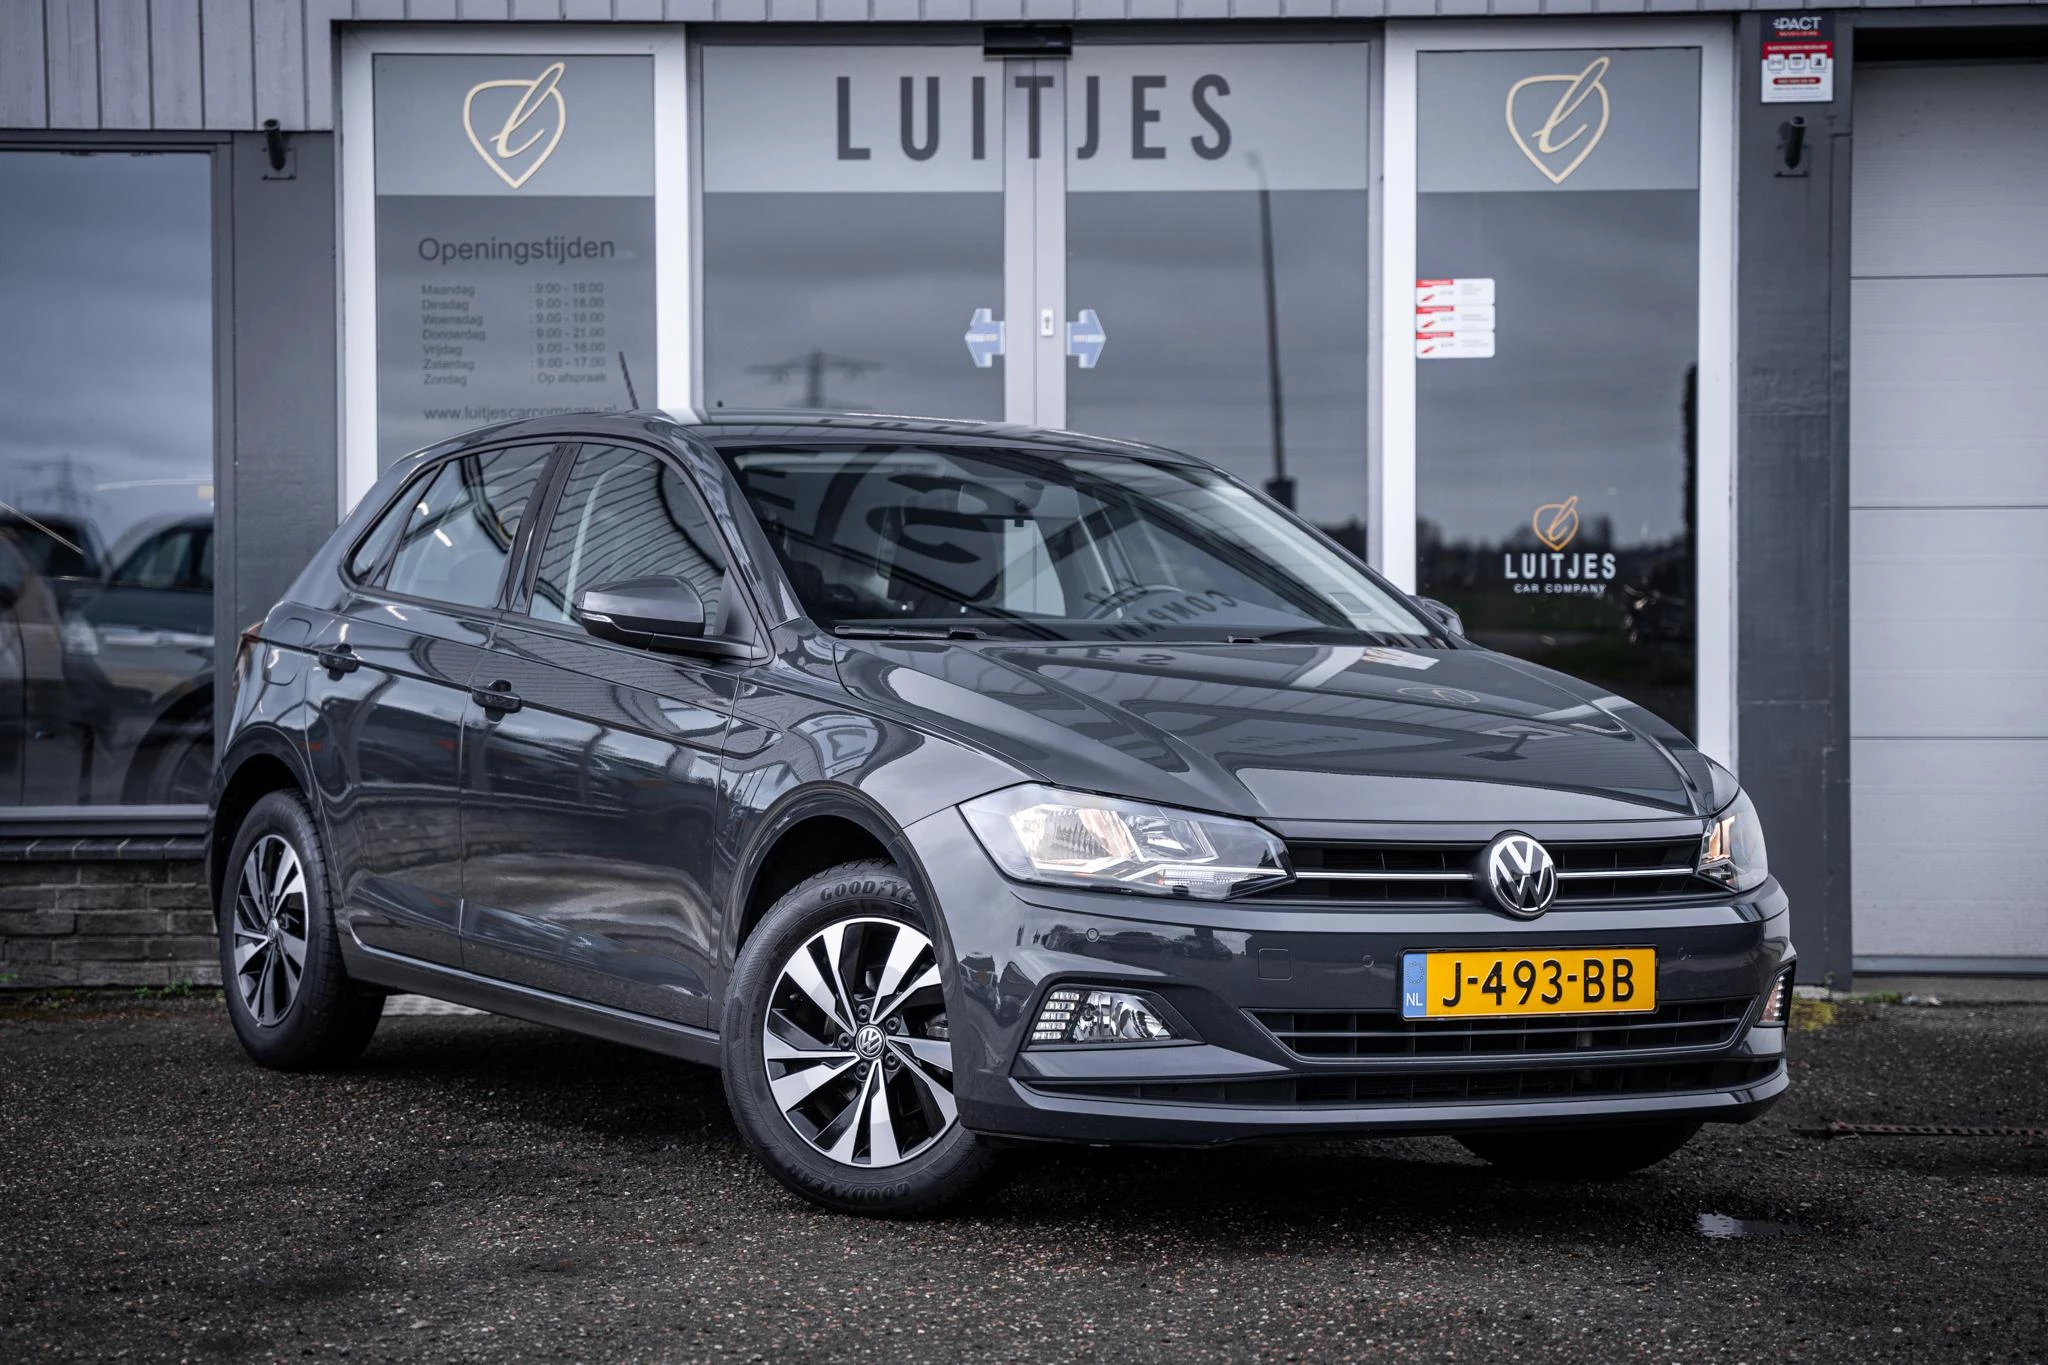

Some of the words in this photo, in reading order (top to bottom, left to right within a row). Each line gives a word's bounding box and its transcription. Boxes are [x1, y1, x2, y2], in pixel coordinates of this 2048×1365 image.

[836, 73, 1232, 161] LUITJES
[418, 236, 615, 266] Openingstijden
[420, 284, 476, 297] Maandag
[421, 299, 470, 312] Dinsdag
[422, 314, 484, 327] Woensdag
[422, 329, 487, 342] Donderdag
[422, 343, 463, 357] Vrijdag
[423, 358, 475, 372] Zaterdag
[423, 373, 468, 388] Zondag
[1504, 553, 1616, 579] LUITJES
[1513, 583, 1540, 594] CAR
[1544, 583, 1607, 594] COMPANY
[1442, 958, 1635, 1008] J-493-BB
[1405, 992, 1423, 1007] NL
